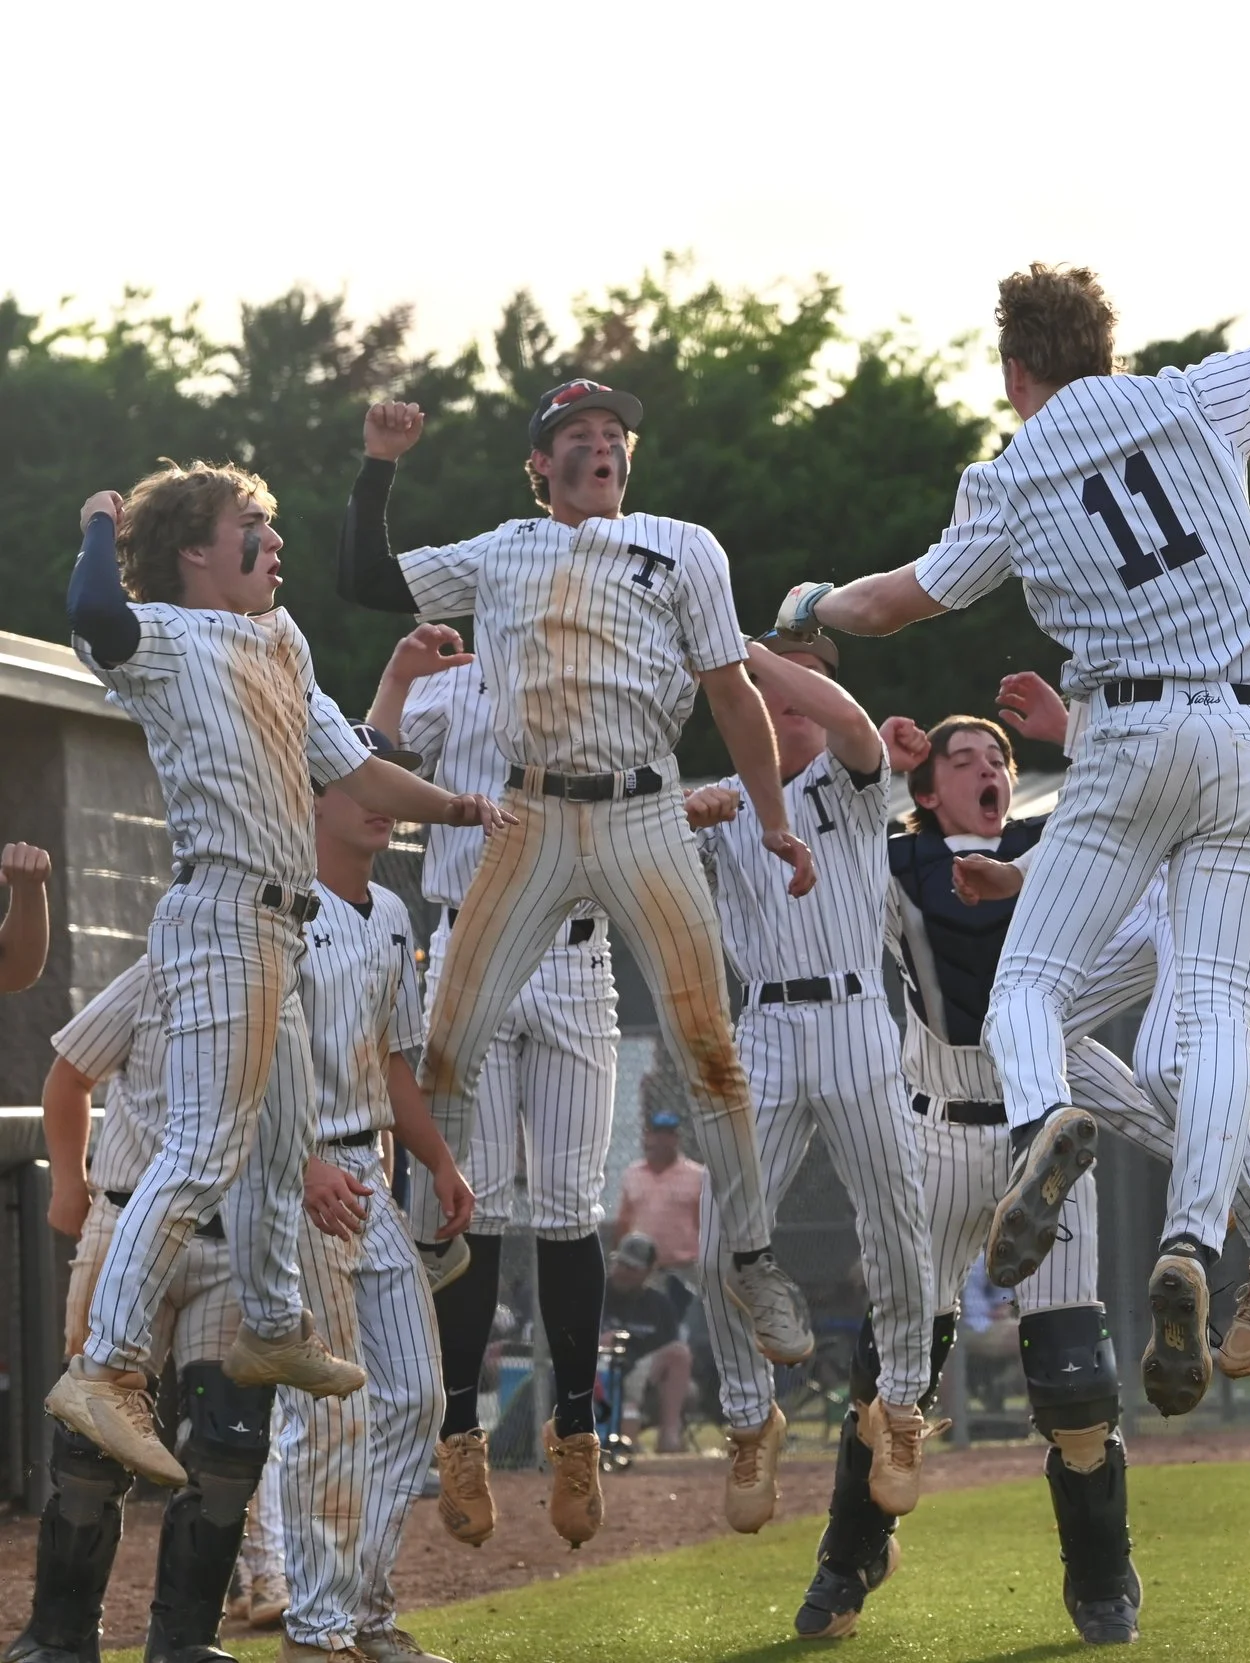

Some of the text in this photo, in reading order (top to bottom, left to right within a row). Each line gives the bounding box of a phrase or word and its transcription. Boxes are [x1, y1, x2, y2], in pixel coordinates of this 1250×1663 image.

[1081, 450, 1207, 591] 11
[627, 544, 676, 590] T
[1178, 690, 1221, 706] Victus
[351, 724, 378, 750] T
[803, 774, 836, 834] T
